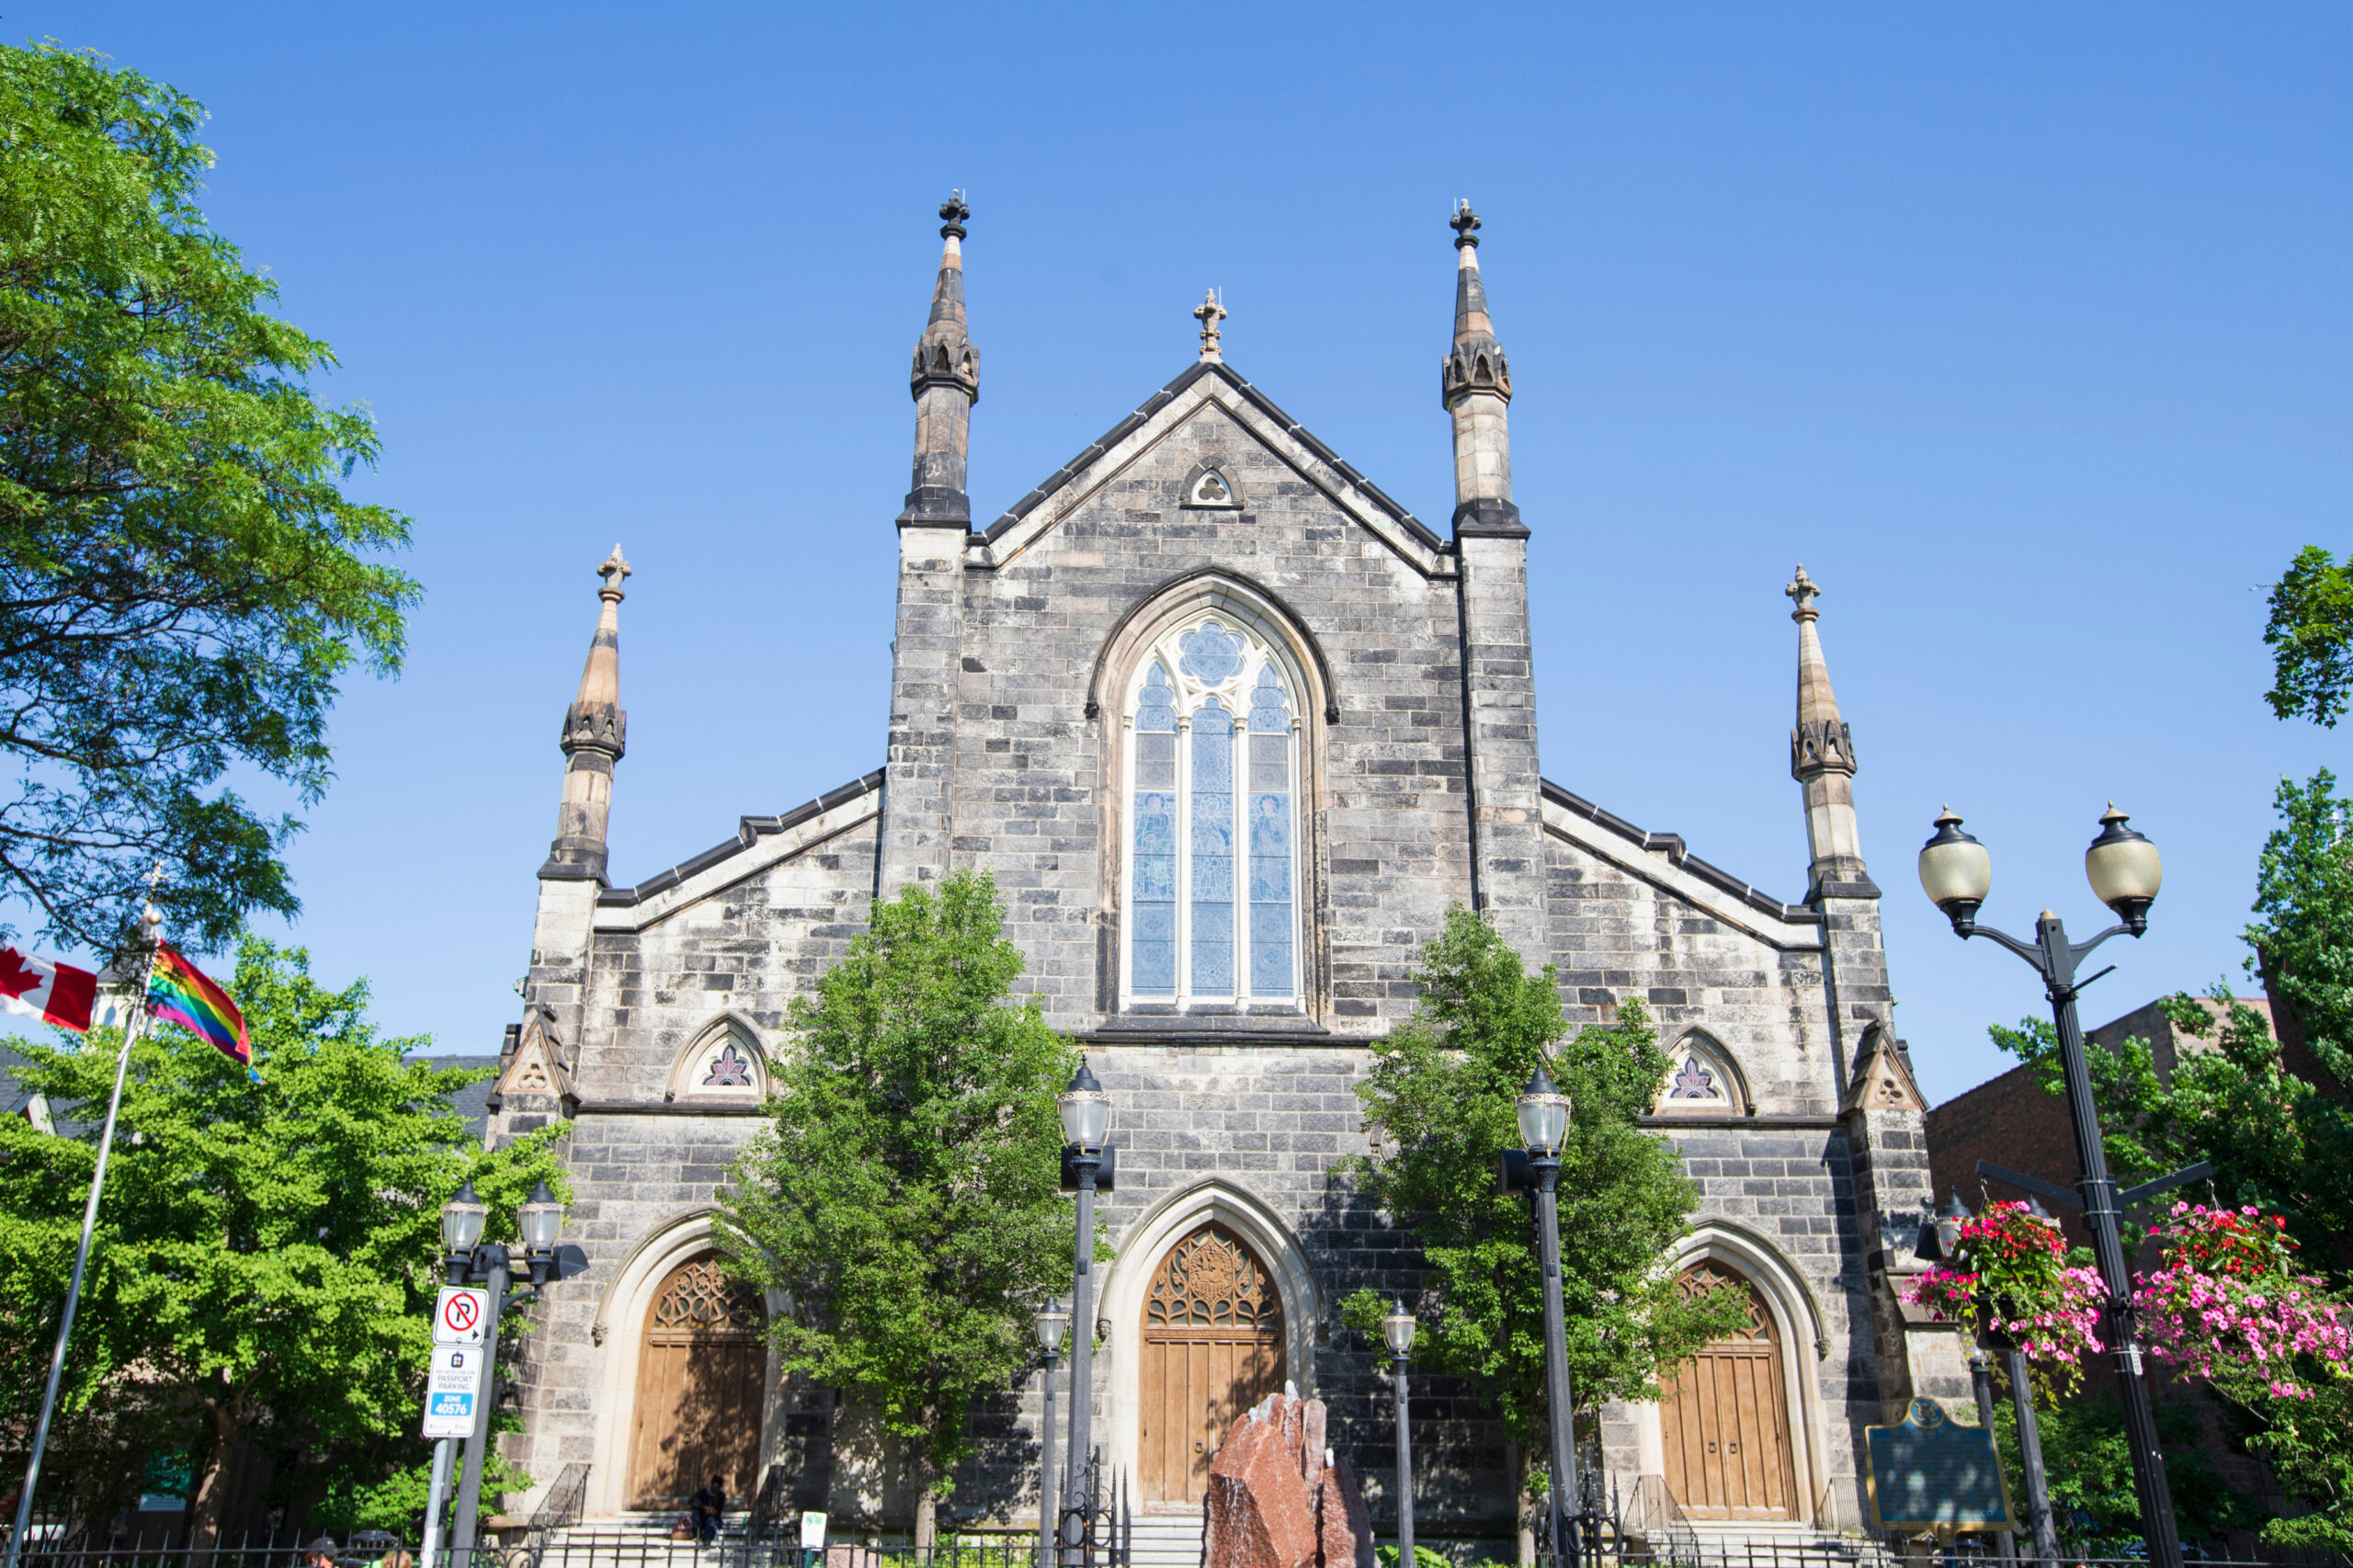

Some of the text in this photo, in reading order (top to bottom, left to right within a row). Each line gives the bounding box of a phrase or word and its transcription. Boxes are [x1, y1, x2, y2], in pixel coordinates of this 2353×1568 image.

[456, 1302, 470, 1322] P
[437, 1374, 472, 1382] PASSPORT
[435, 1403, 467, 1415] 40576
